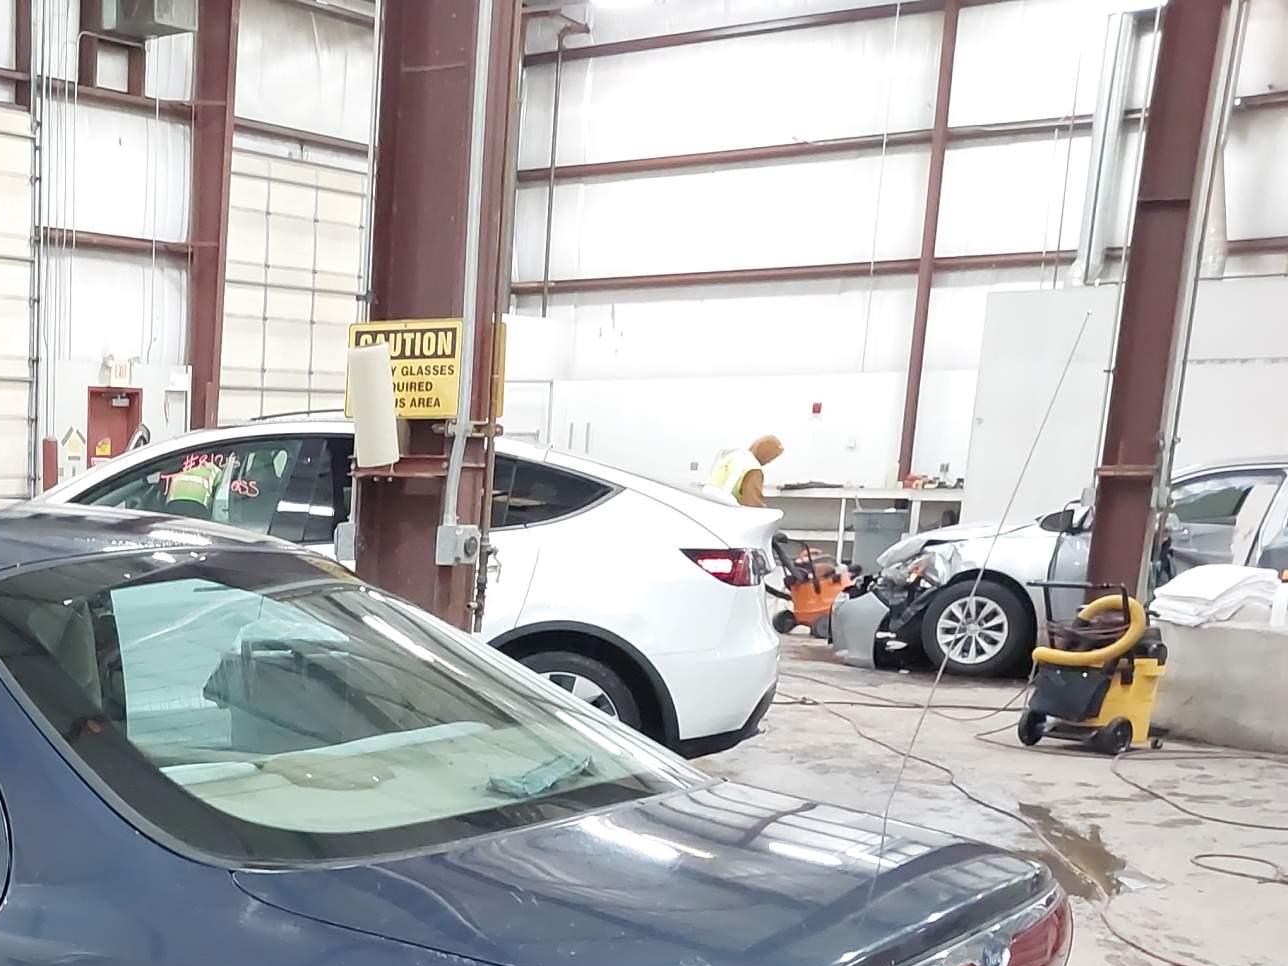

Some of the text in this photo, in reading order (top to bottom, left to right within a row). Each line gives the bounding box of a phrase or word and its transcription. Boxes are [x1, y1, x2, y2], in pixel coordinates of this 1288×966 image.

[401, 364, 455, 377] GLASSES
[393, 381, 433, 393] UIRED
[410, 397, 441, 408] AREA
